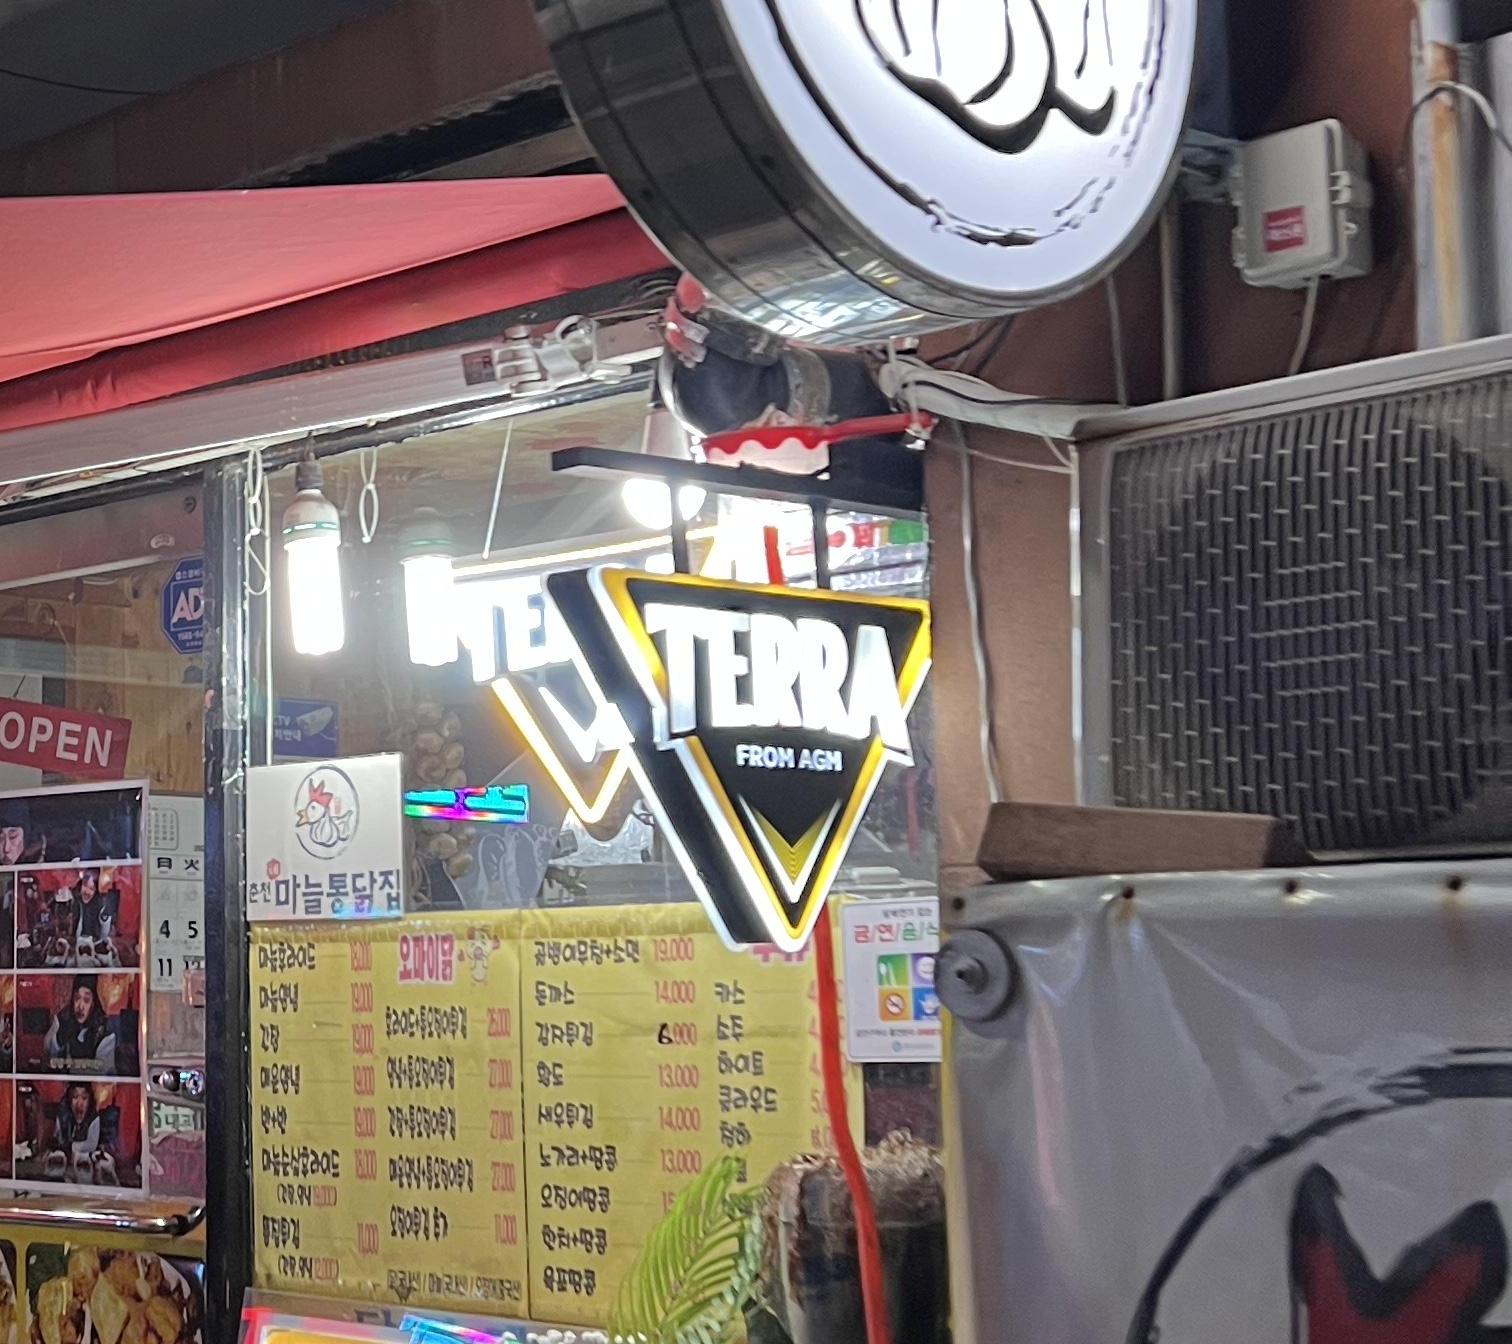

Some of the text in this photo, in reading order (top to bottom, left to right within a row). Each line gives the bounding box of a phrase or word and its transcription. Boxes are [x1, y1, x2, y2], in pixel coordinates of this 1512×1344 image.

[171, 587, 205, 624] AD
[645, 602, 910, 753] TERRA
[736, 744, 843, 773] FROM AGM
[184, 859, 199, 872] 火
[275, 869, 401, 916] 마늘통닭집
[159, 919, 198, 939] 4 5
[258, 941, 315, 973] 마늘후라이드
[535, 937, 694, 966] 골뱅이무침+소면 19,000
[158, 958, 173, 977] 11
[259, 981, 299, 1013] 마늘양념
[535, 980, 695, 1006] 돈까스 14,000
[714, 979, 745, 1005] 카스
[535, 1022, 593, 1047] 감자튀김
[658, 1063, 699, 1088] 13,000
[718, 1050, 764, 1076] 하이트
[260, 1063, 300, 1095] 매운양념
[719, 1084, 778, 1113] 클라우드
[538, 1103, 700, 1131] 새우튀김 14,000
[539, 1143, 617, 1172] 노가리+땅콩
[660, 1148, 701, 1174] 13,000
[541, 1183, 611, 1213] 오징어땅콩
